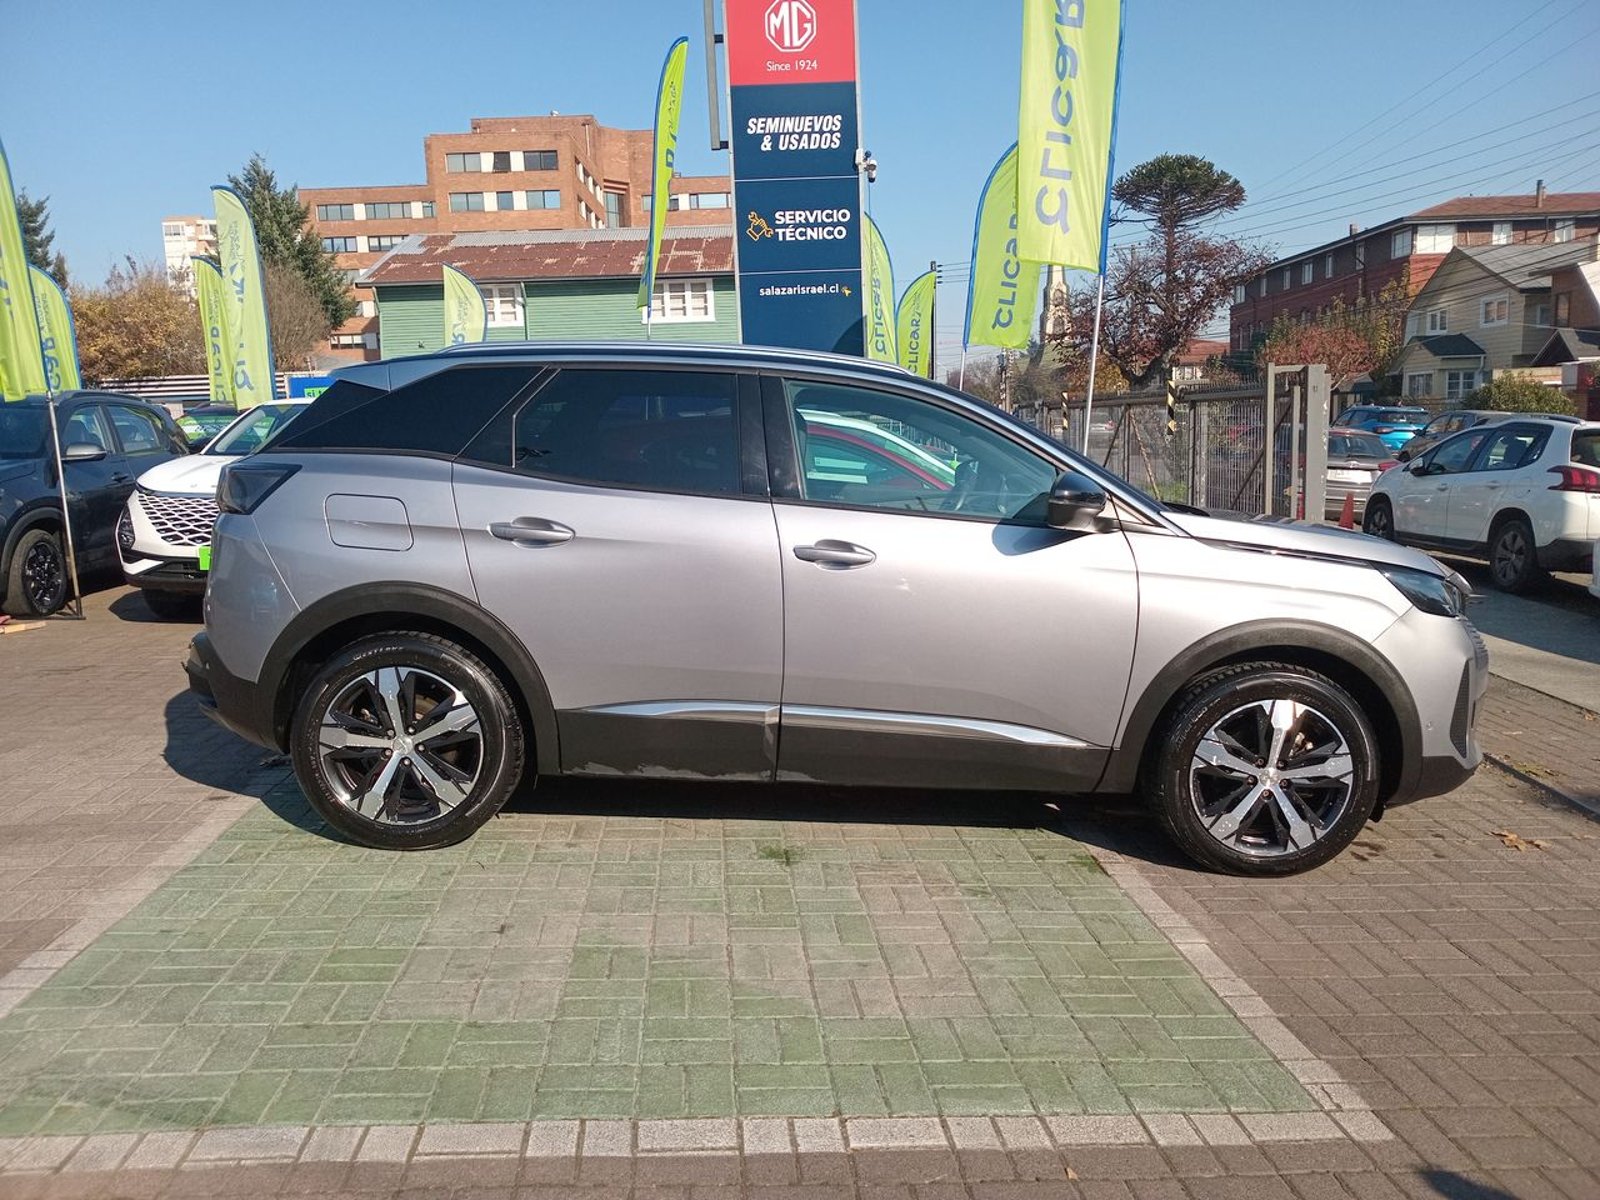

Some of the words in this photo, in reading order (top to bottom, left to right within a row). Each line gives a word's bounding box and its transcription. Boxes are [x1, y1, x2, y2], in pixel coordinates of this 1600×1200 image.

[769, 1, 812, 47] MG
[766, 60, 790, 72] Since
[795, 59, 818, 70] 1924
[747, 114, 842, 134] SEMINUEVOS
[760, 135, 772, 151] &
[778, 132, 841, 151] USADOS
[774, 209, 851, 224] SERVICIO
[775, 225, 847, 241] TÉCNICO
[760, 284, 839, 296] salazarisrael.cl
